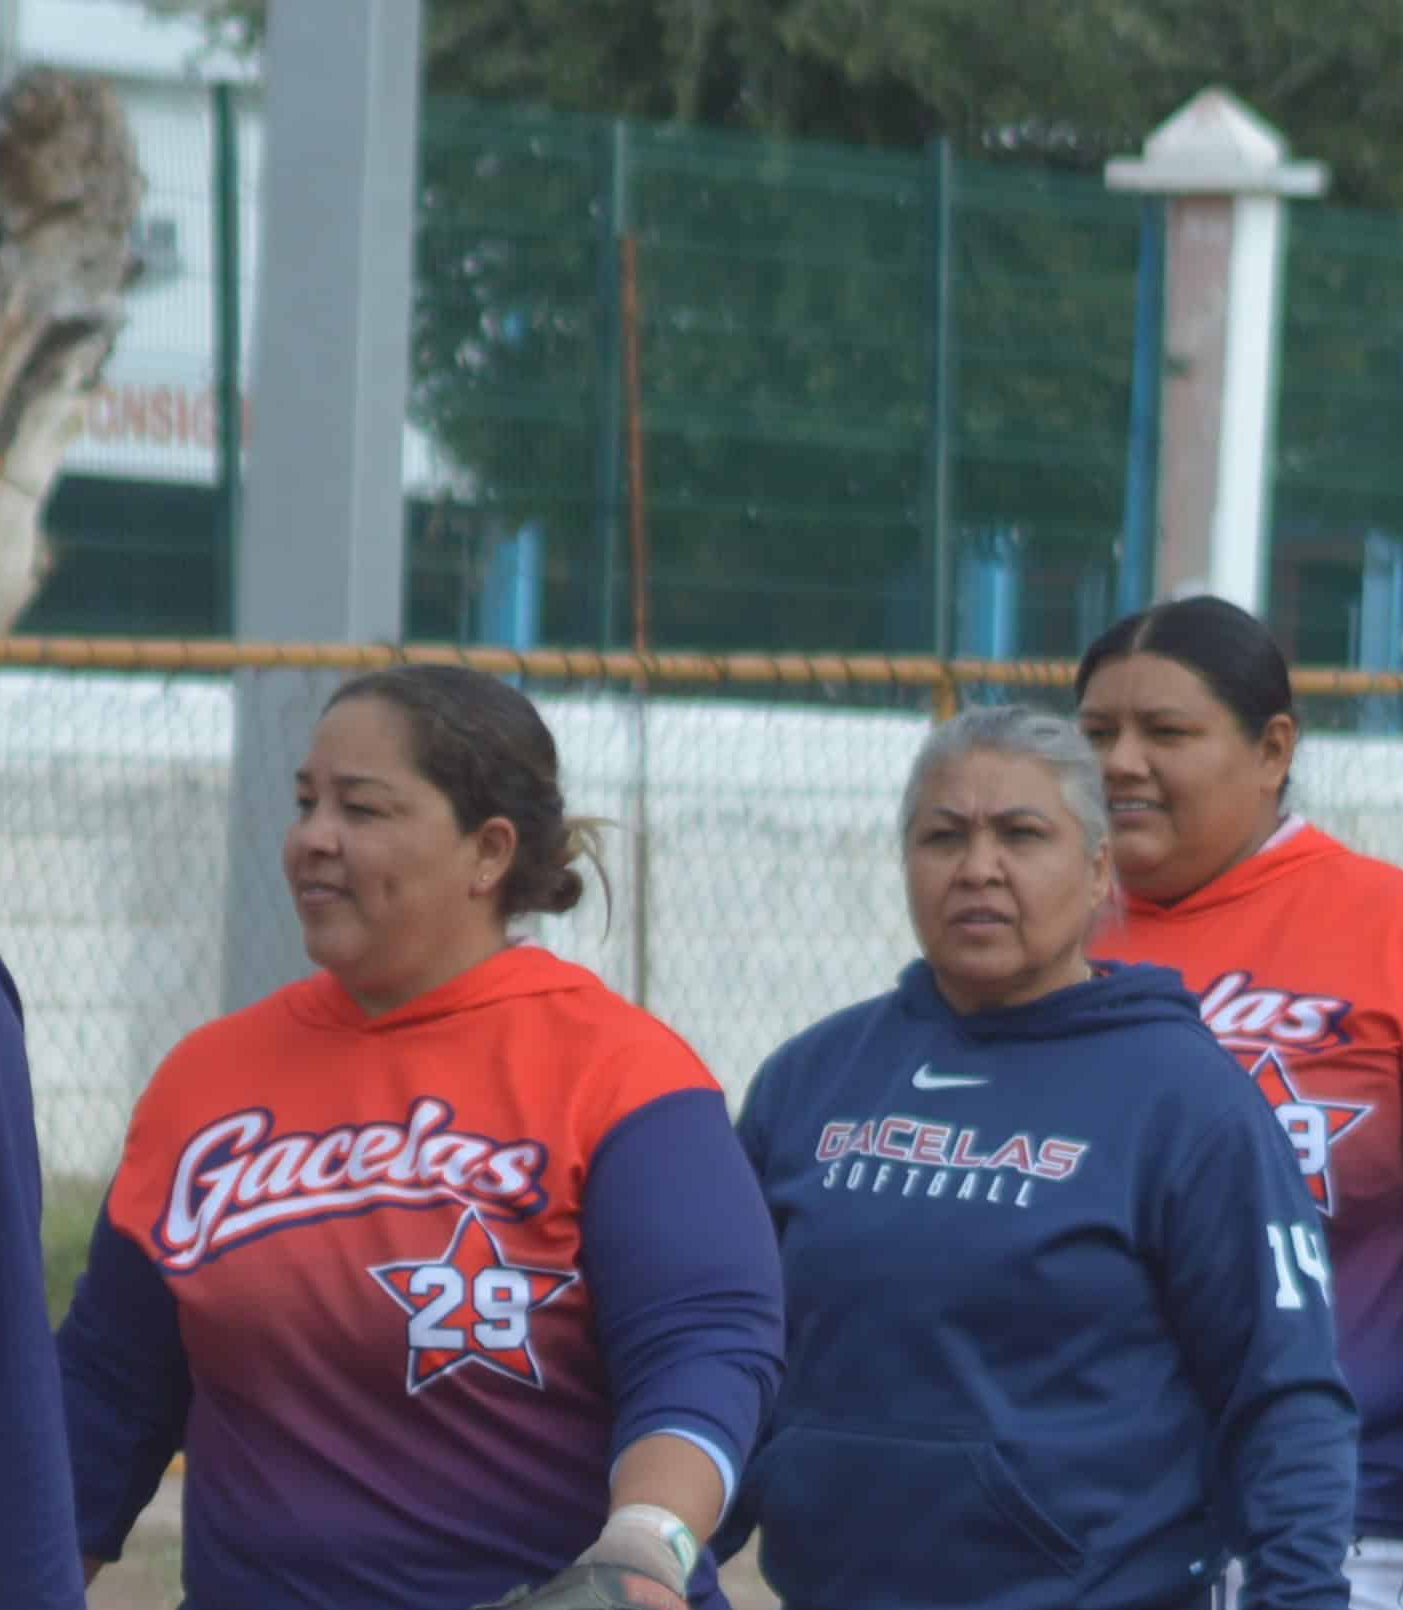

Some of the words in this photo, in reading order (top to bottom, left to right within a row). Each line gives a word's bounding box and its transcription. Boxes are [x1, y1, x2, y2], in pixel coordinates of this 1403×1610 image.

[815, 1115, 1089, 1181] GACELAS
[1275, 1104, 1327, 1174] 9
[160, 1098, 540, 1268] Gacelas
[823, 1161, 1033, 1208] SOFTBALL
[1266, 1225, 1331, 1310] 14
[407, 1265, 531, 1350] 29
